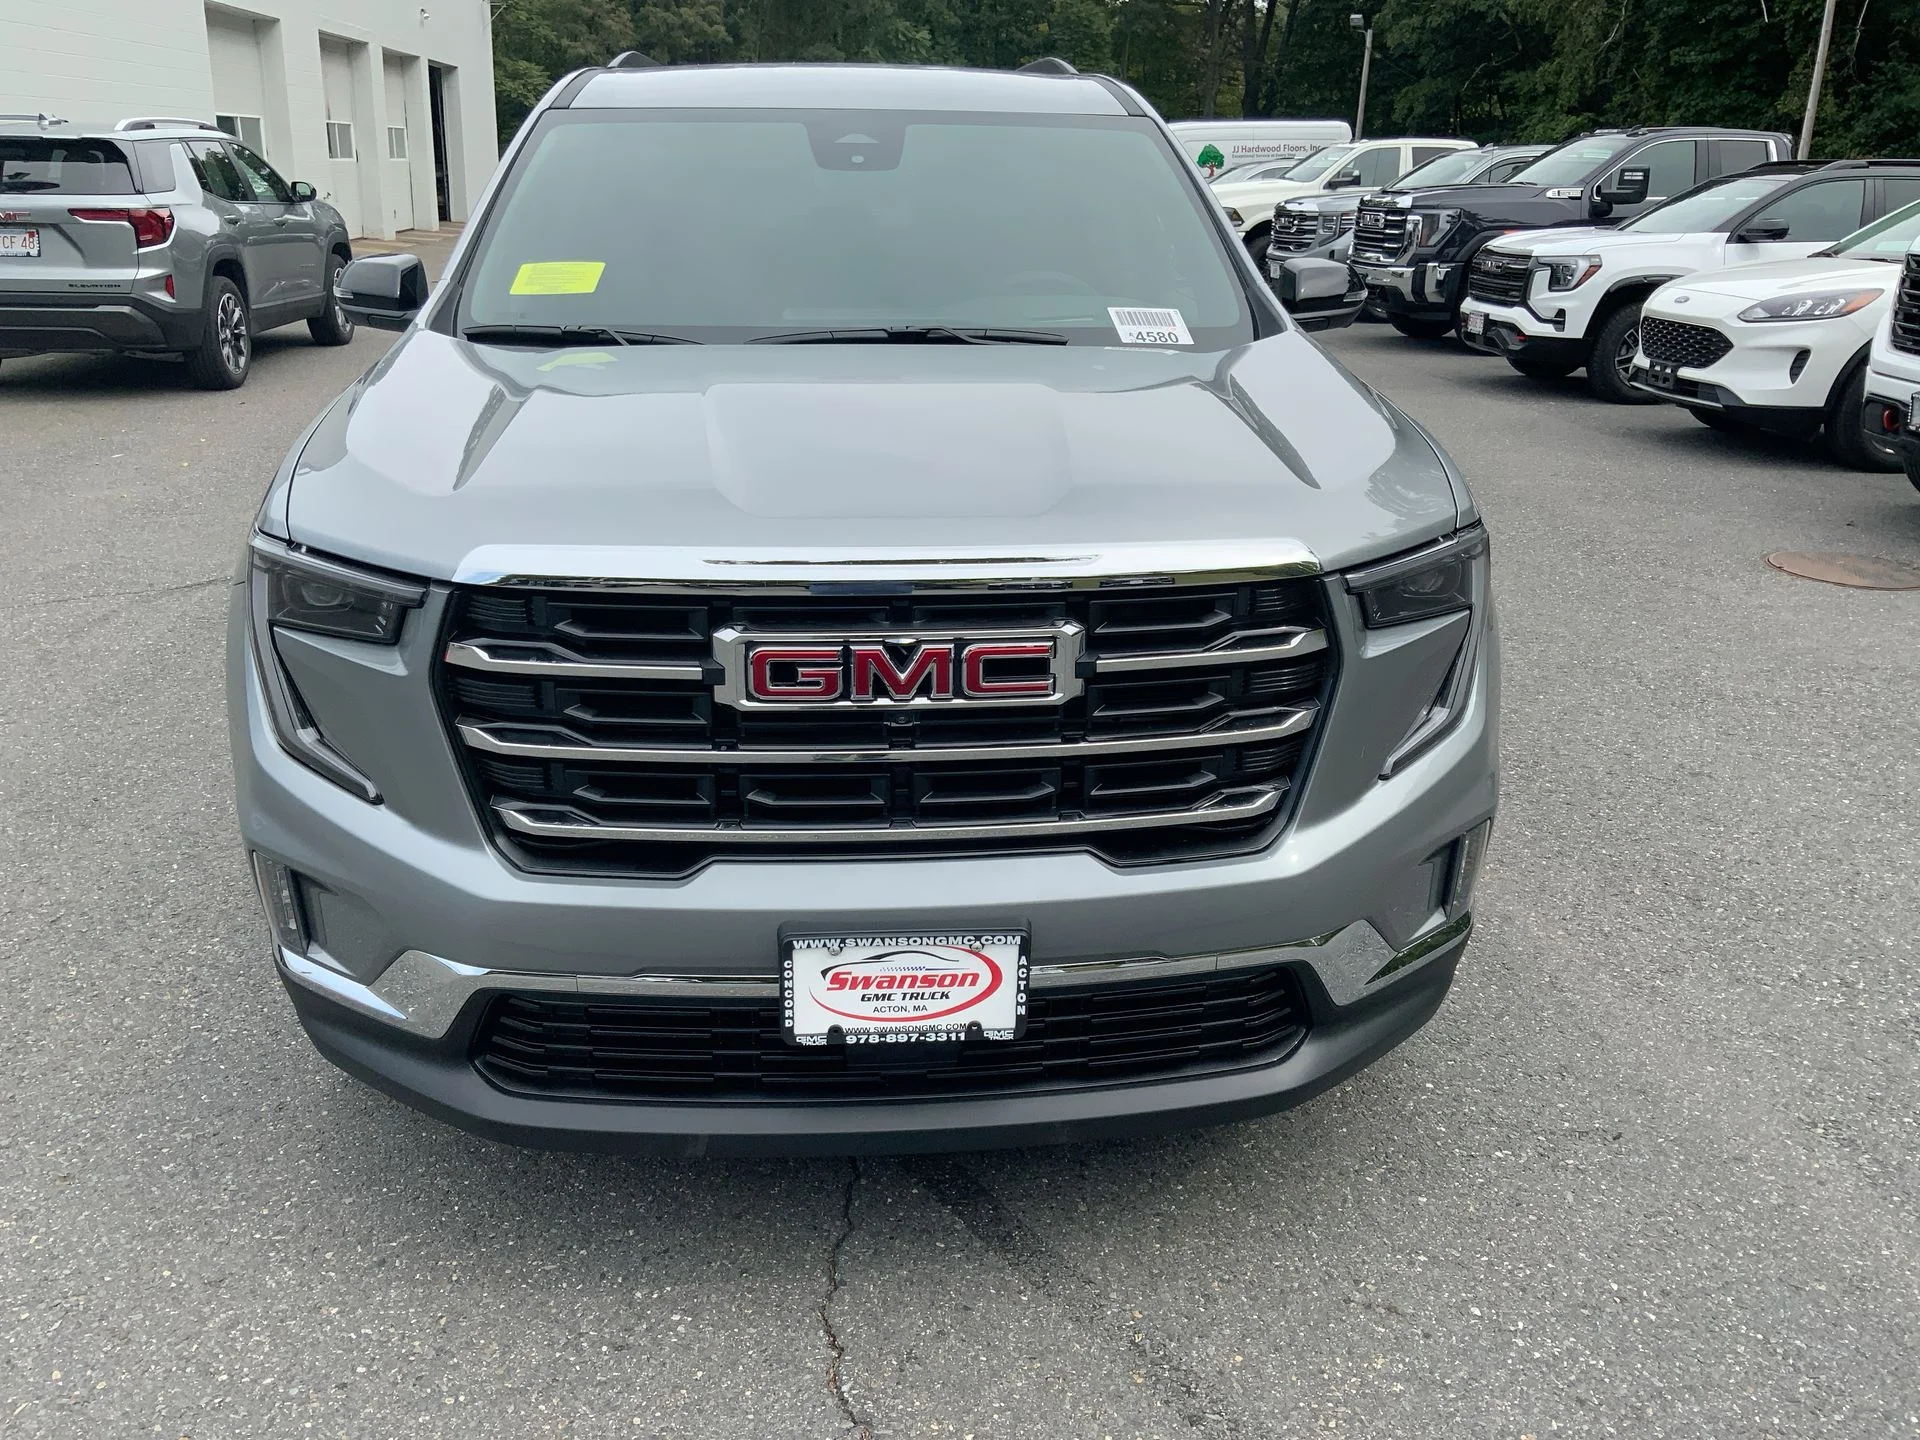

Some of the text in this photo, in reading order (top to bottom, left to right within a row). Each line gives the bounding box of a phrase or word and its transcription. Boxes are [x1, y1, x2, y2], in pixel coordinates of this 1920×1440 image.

[1232, 145, 1239, 153] JJ
[1241, 144, 1281, 152] Hardwood
[1283, 144, 1309, 152] Floors,
[0, 211, 31, 222] MC
[0, 235, 35, 249] CF 48
[1135, 331, 1179, 343] 4580
[750, 641, 1055, 701] GMC
[792, 935, 1021, 949] WWW.SWANSONGMC.COM
[826, 971, 980, 991] Swanson
[1016, 955, 1027, 1016] ACTON
[783, 960, 793, 1028] CONCORD
[860, 990, 951, 1002] GMC TRUCK
[872, 1004, 928, 1014] ACTON, MA
[844, 1022, 968, 1034] WWWSWANSONGMC.COM
[983, 1030, 1014, 1038] GMC
[796, 1035, 828, 1043] GMC
[845, 1031, 966, 1044] 978-897-3311
